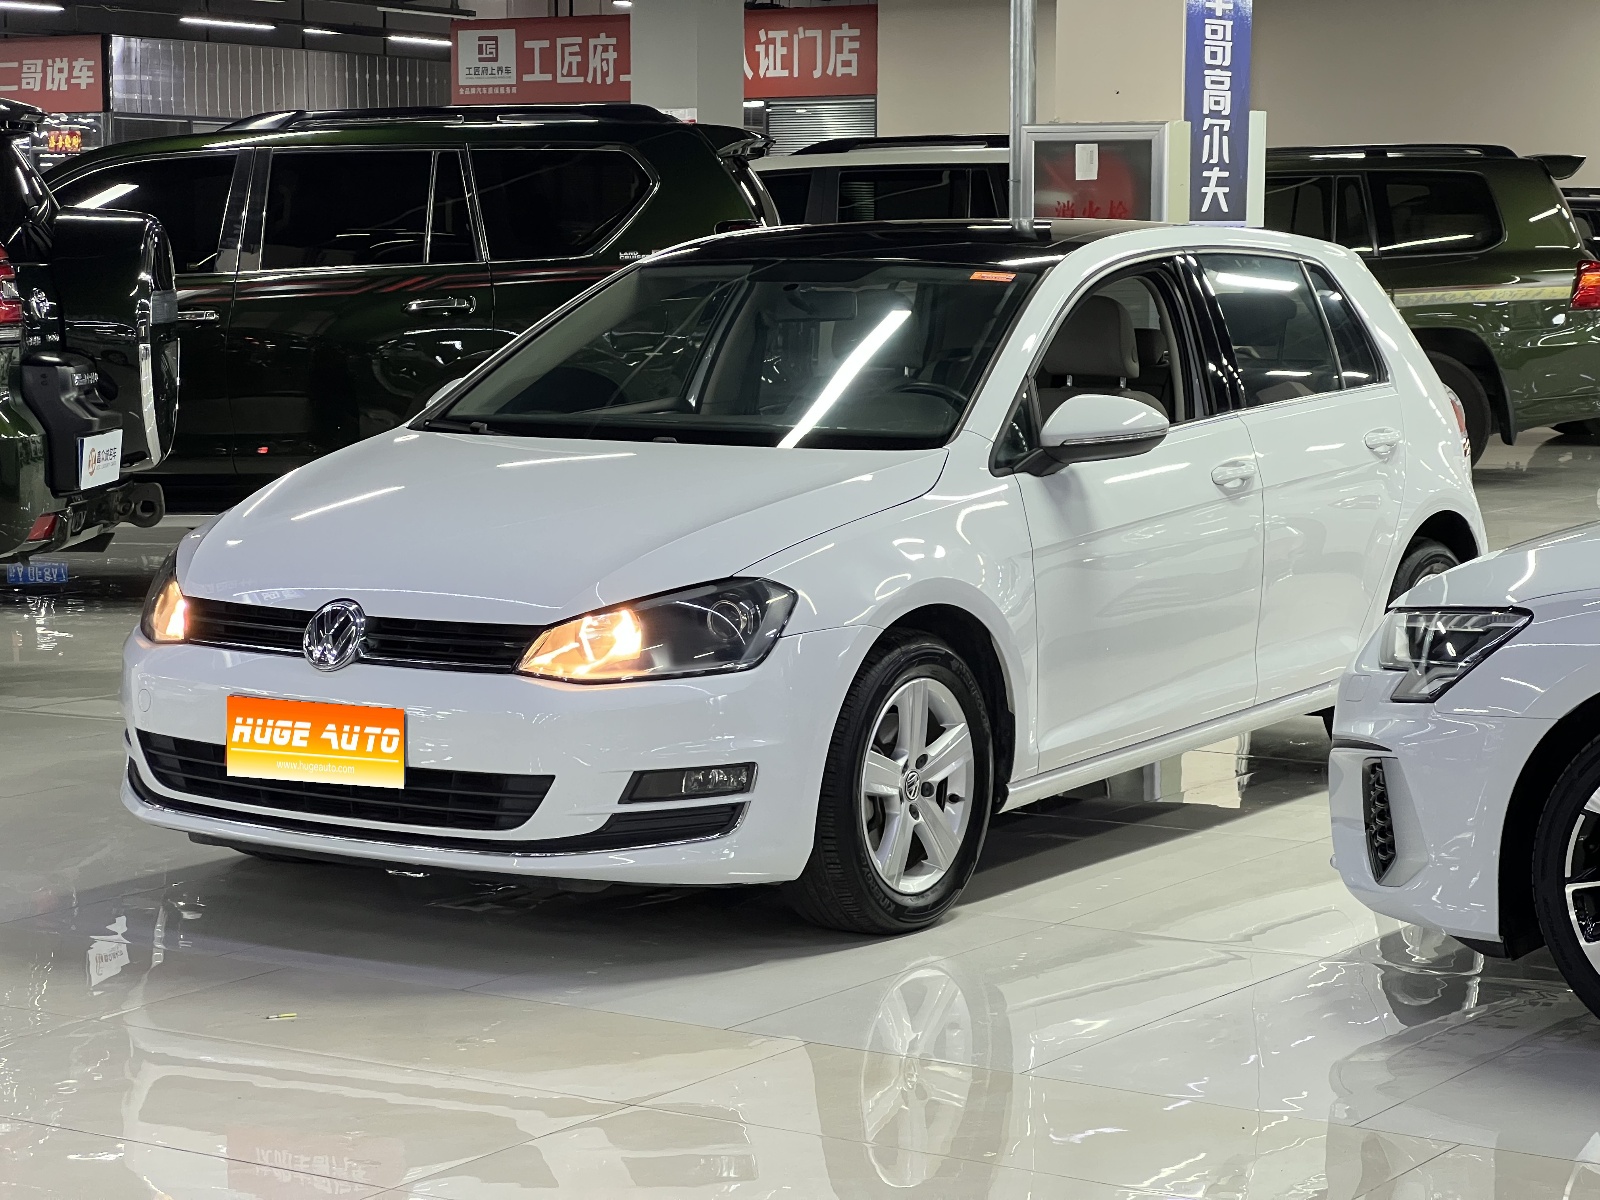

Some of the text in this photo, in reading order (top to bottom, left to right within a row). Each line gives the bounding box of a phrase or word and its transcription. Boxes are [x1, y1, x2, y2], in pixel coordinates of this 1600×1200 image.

[466, 66, 512, 76] 工匠府上养车
[522, 22, 861, 85] 工匠府 证门店
